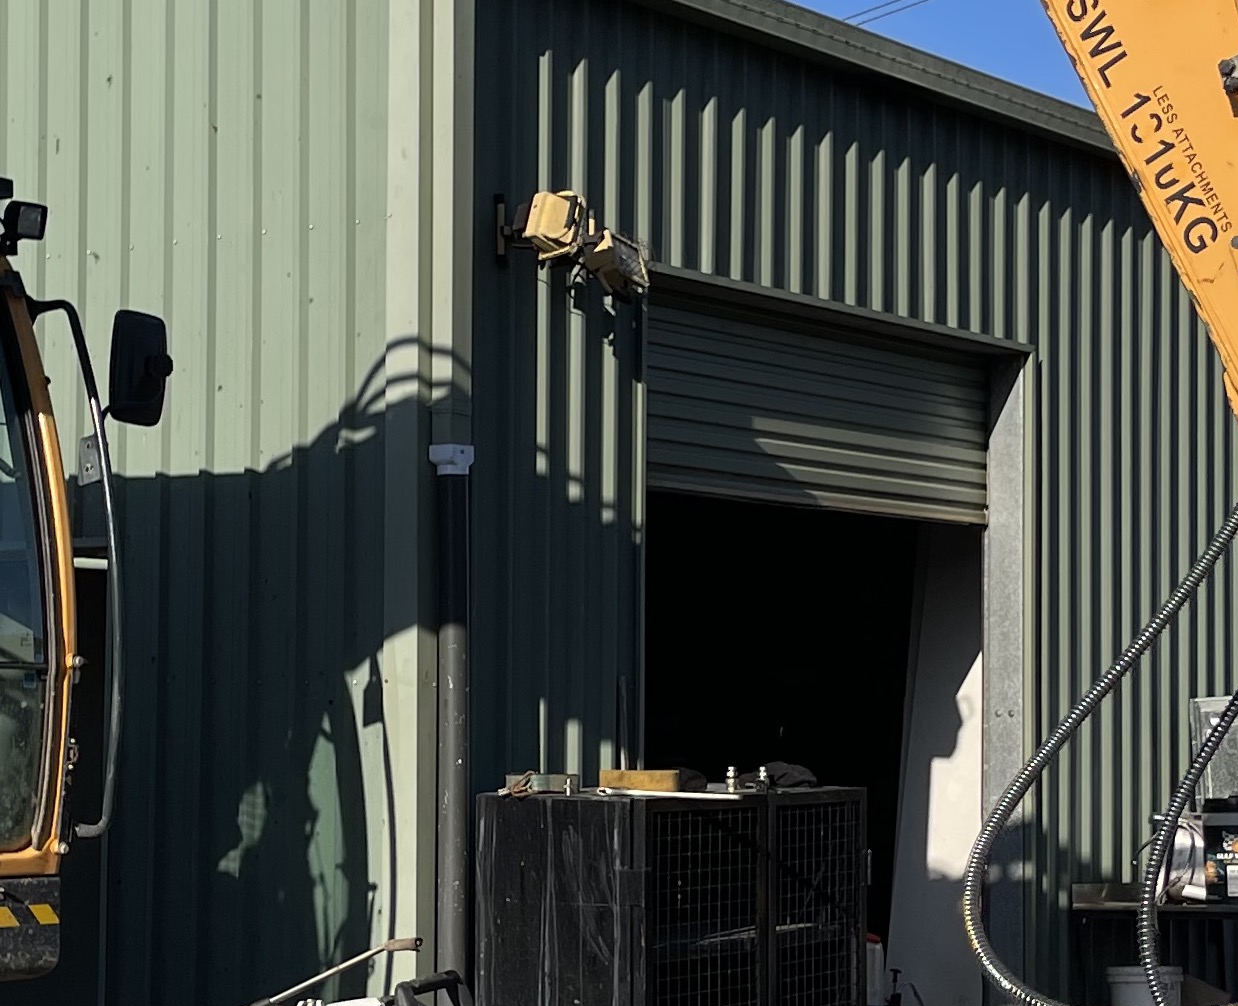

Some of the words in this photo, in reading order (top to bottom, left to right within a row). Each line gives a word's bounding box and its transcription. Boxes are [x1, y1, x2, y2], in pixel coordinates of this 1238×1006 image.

[1066, 0, 1127, 88] SWL
[1153, 85, 1178, 124] LESS
[1172, 127, 1233, 233] ATTACHMENTS
